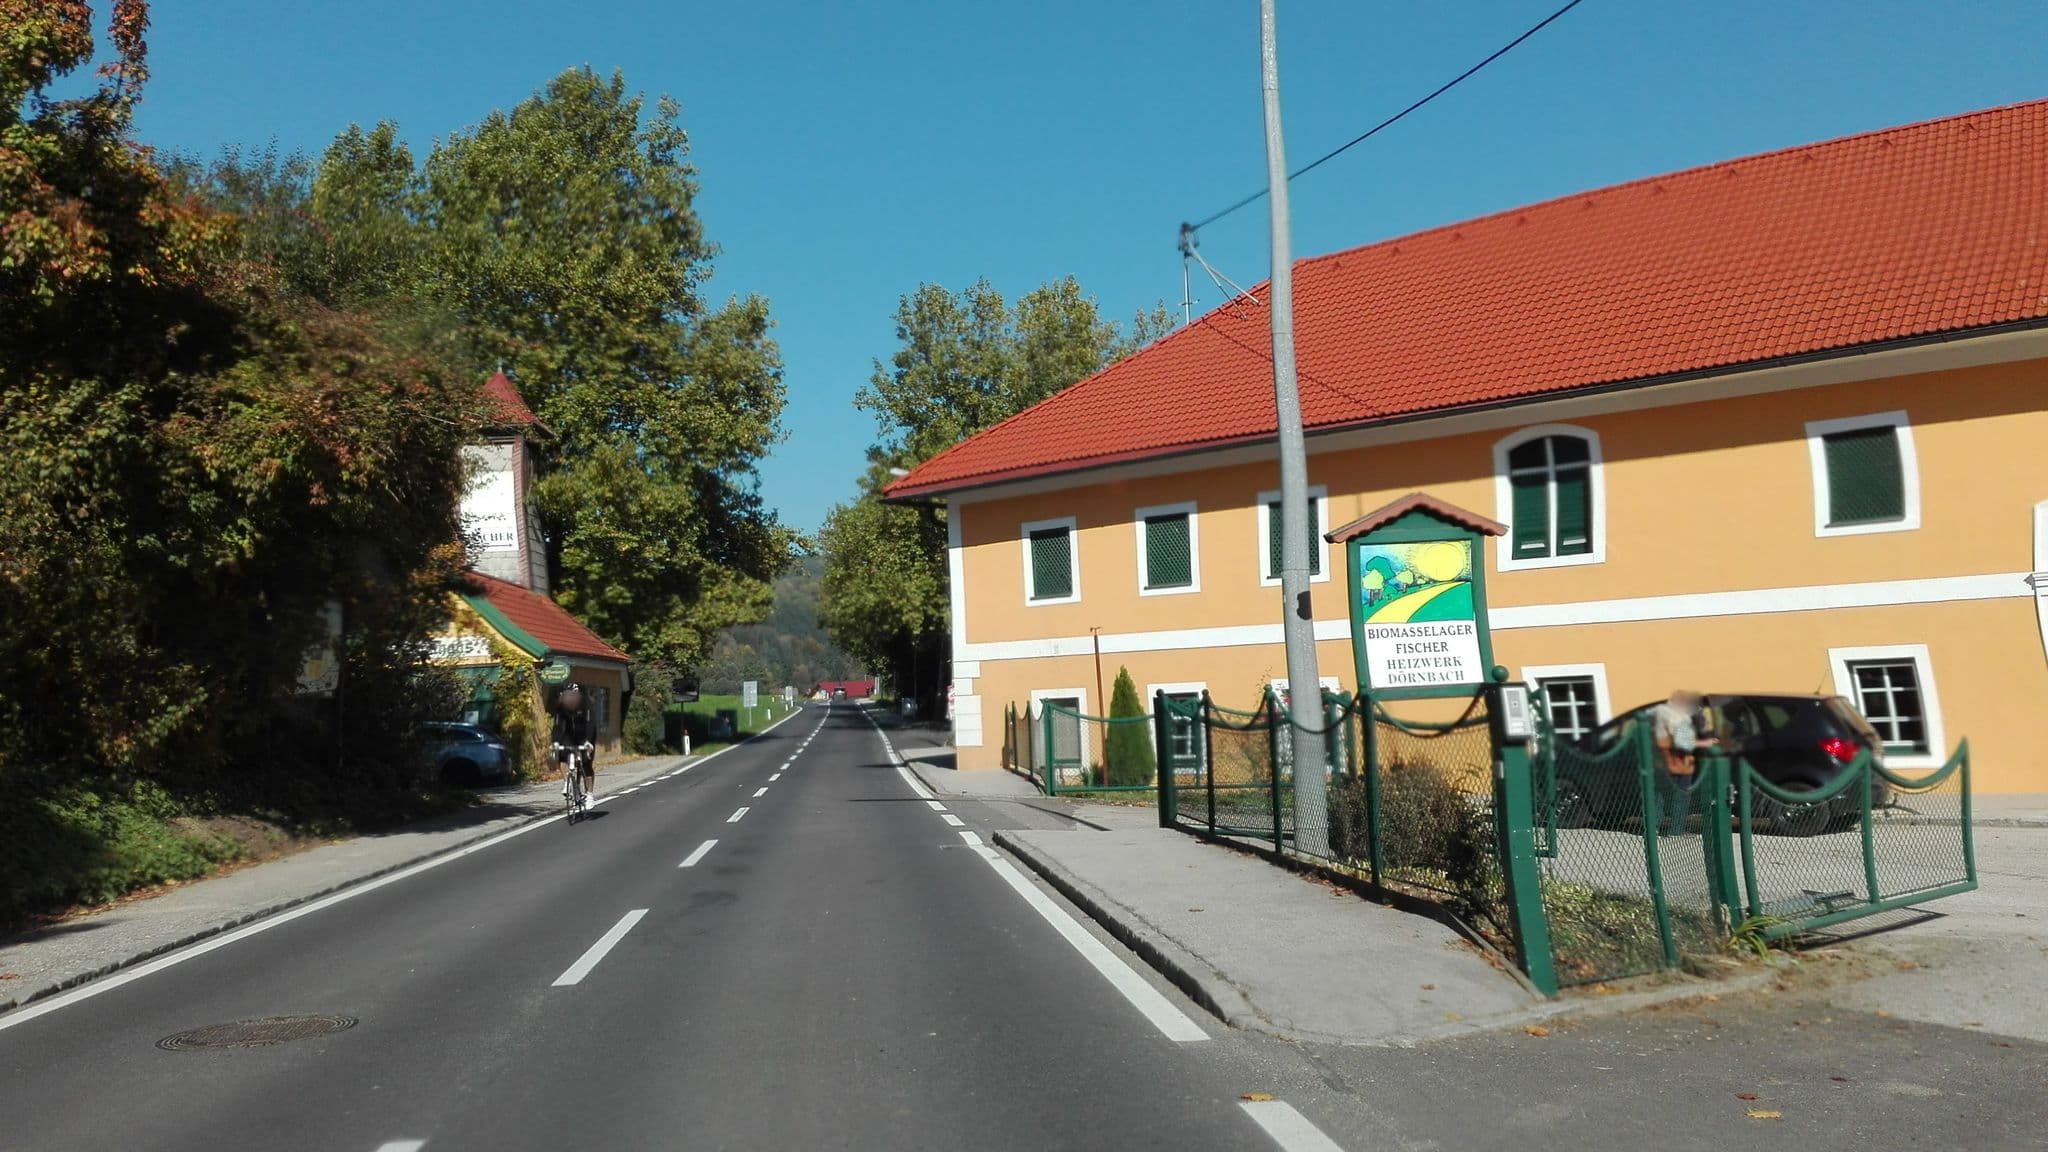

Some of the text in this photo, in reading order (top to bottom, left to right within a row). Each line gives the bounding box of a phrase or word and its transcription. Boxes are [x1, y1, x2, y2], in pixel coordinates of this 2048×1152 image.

[1367, 624, 1473, 640] BIOMASSELAGER
[1395, 641, 1449, 655] FISCHER
[1387, 656, 1463, 670] HEIZWERK
[1388, 670, 1464, 685] DÖRNBACH
